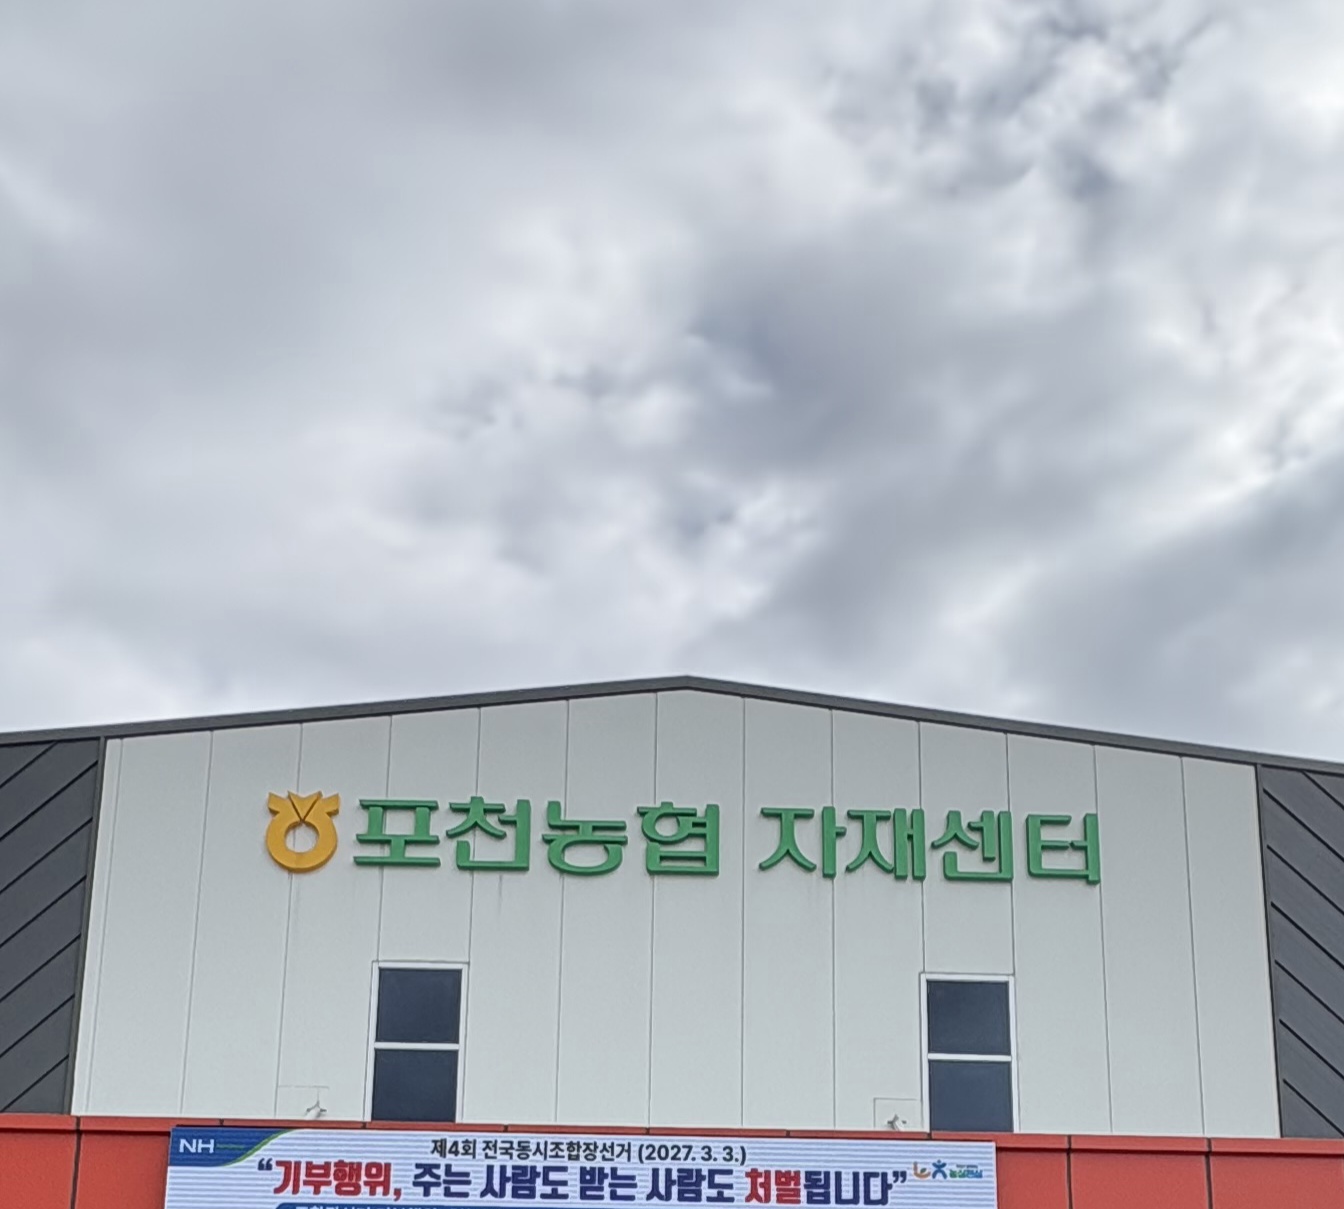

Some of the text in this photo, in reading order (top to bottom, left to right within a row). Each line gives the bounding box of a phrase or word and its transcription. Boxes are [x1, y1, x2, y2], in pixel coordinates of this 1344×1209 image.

[352, 795, 1102, 884] 포천농협 자재센터
[179, 1139, 214, 1153] NH
[431, 1138, 477, 1159] 제4회
[482, 1140, 632, 1162] 전국동시조합장선거
[412, 1162, 472, 1199] 주는
[480, 1163, 570, 1200] 사람도
[579, 1165, 638, 1201] 받는
[645, 1167, 735, 1203] 사람도
